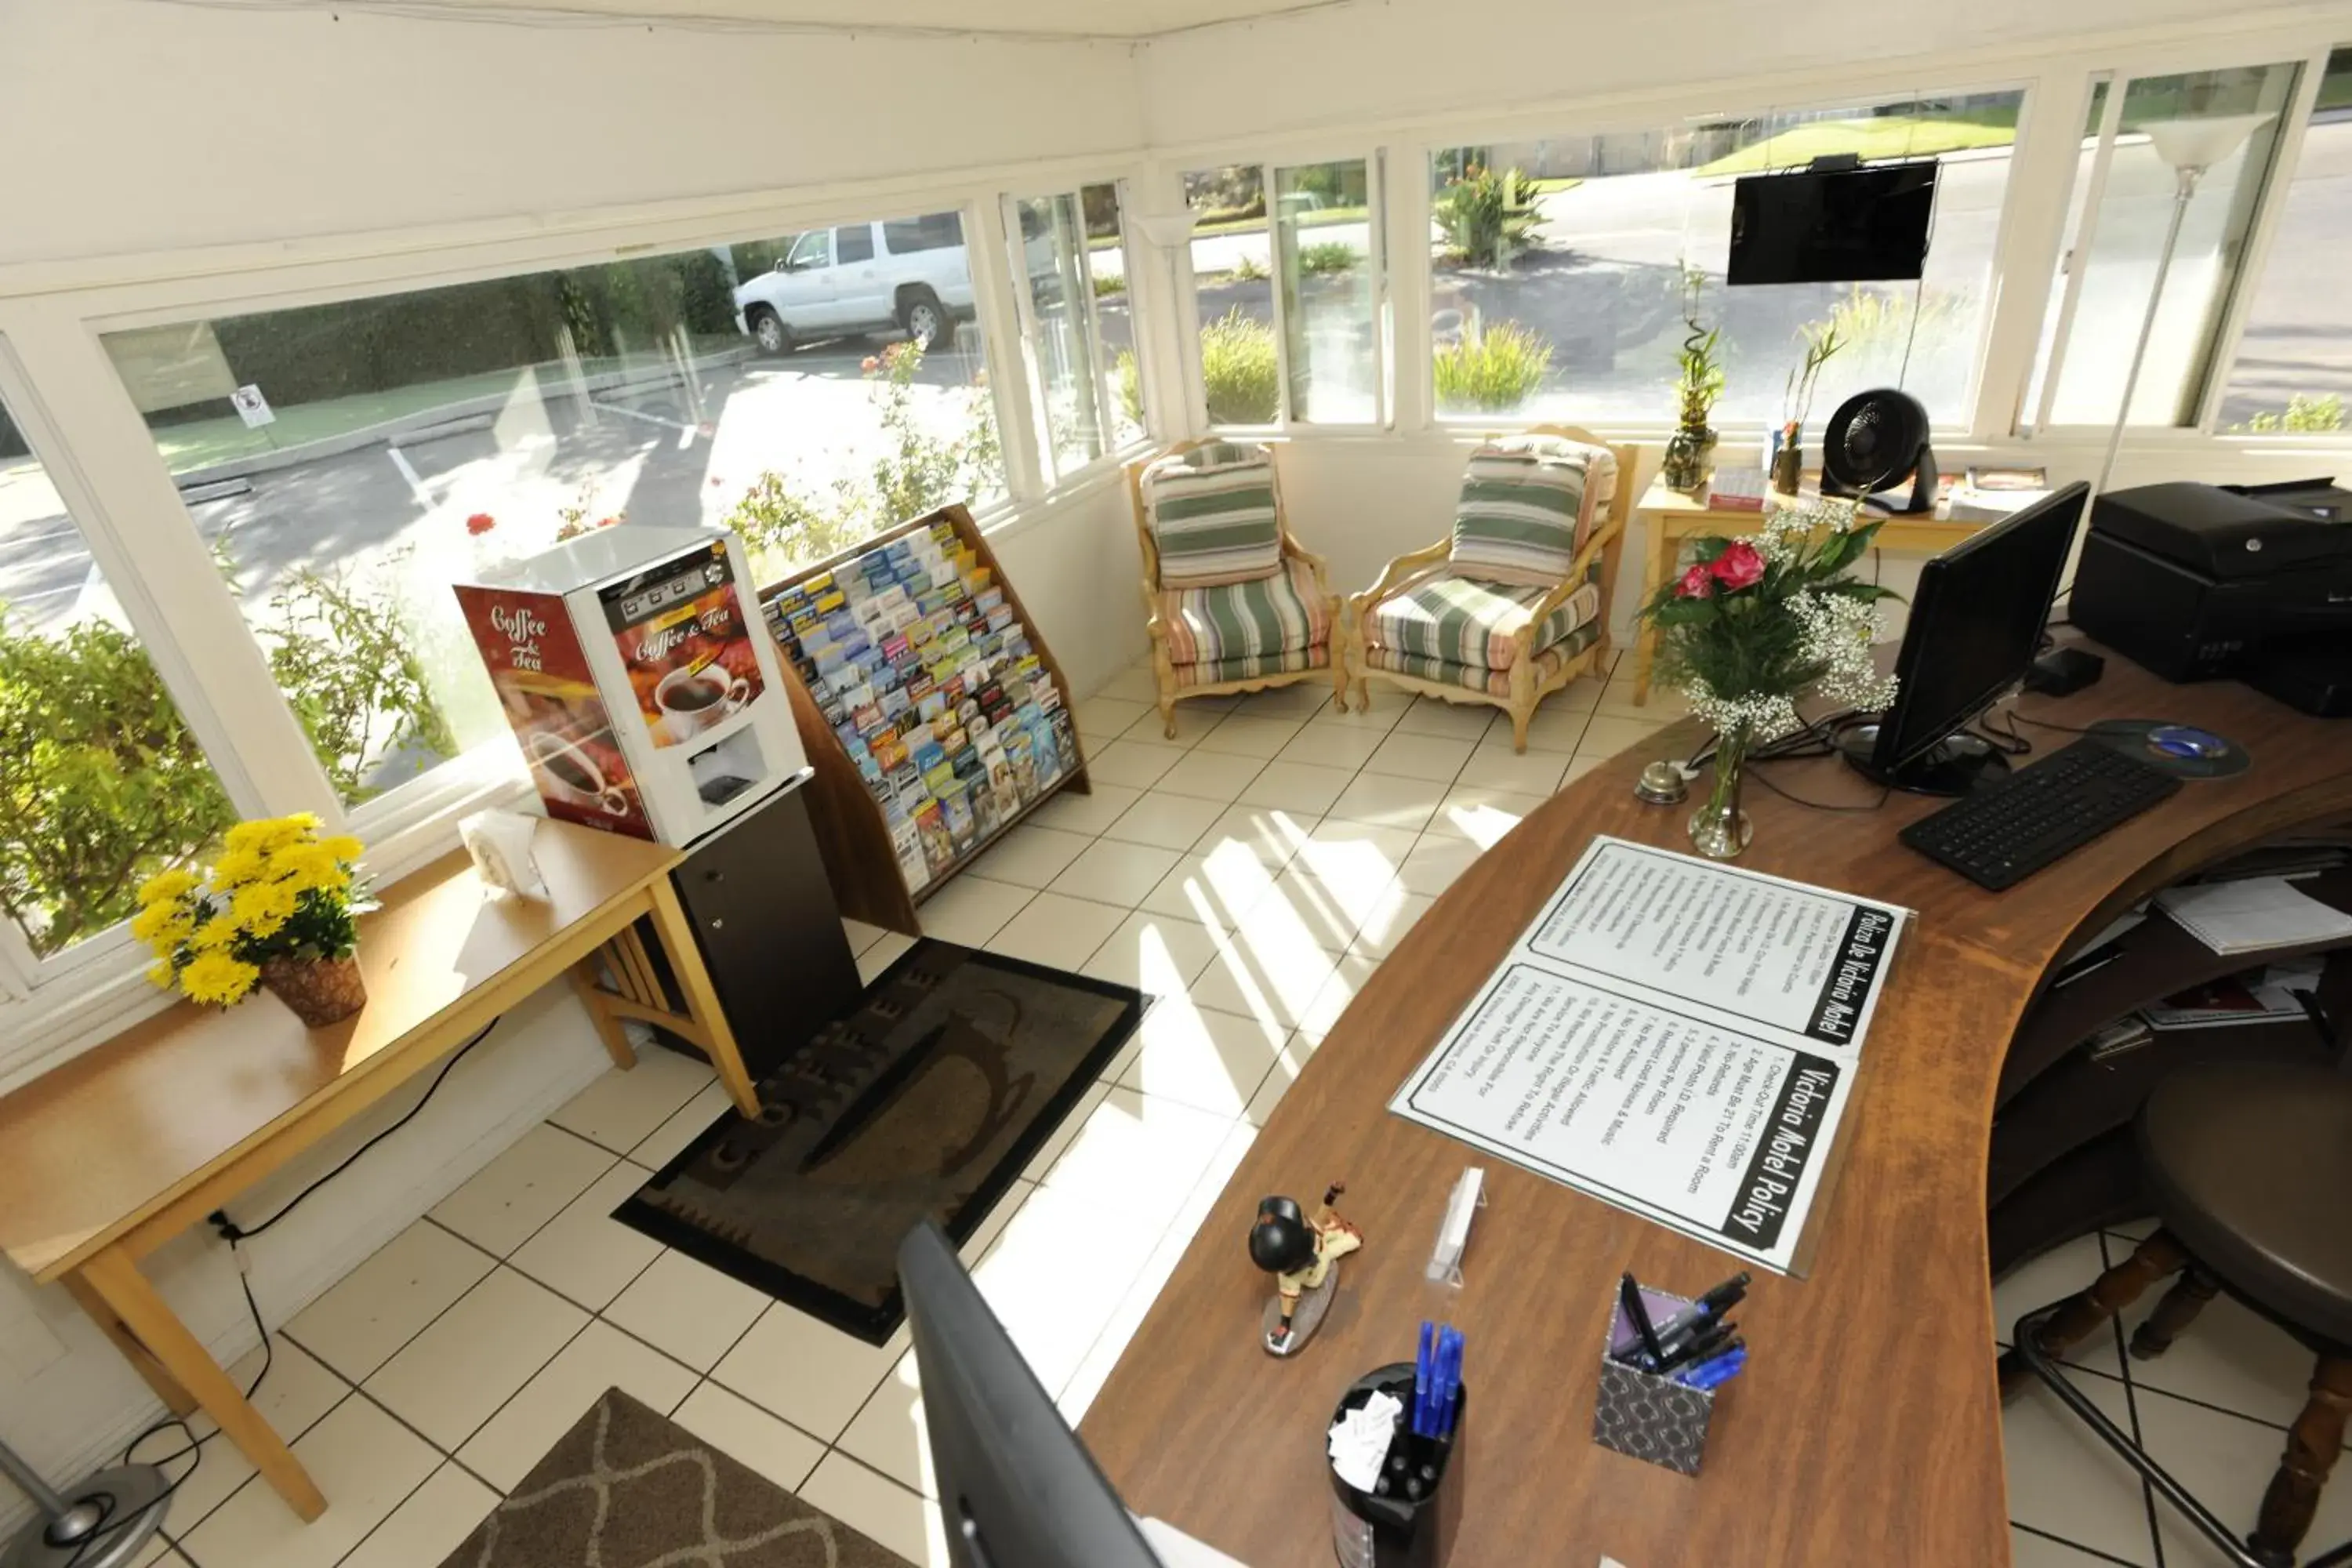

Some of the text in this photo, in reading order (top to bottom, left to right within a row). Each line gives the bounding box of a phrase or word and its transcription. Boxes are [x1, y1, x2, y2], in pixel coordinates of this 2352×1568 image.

[491, 604, 546, 643] Coffee
[635, 629, 686, 662] Coffee
[702, 606, 730, 632] Tea
[510, 645, 542, 671] Tea
[1848, 942, 1876, 957] De
[1831, 960, 1870, 1000] Victoria
[1531, 1007, 1546, 1021] Are
[1599, 1010, 1614, 1022] No
[1620, 1016, 1635, 1028] No
[1818, 1000, 1853, 1037] Motel
[1545, 1022, 1561, 1033] To
[1639, 1022, 1654, 1035] No
[1483, 1044, 1496, 1055] Or
[1526, 1033, 1552, 1062] Anyone
[1573, 1021, 1608, 1064] Prostitution
[1602, 1029, 1627, 1056] Visitors
[1632, 1033, 1648, 1048] Pet
[1650, 1029, 1675, 1059] Restrict
[1548, 1051, 1566, 1065] The
[1613, 1047, 1639, 1080] Allowed
[1697, 1043, 1716, 1065] Valid
[1742, 1056, 1759, 1074] Age
[711, 966, 942, 1172] COFFEE
[1533, 1065, 1555, 1089] Right
[1566, 1064, 1580, 1076] Or
[1581, 1065, 1605, 1091] Traffic
[1638, 1058, 1657, 1081] Loud
[1684, 1063, 1706, 1087] Photo
[1478, 1081, 1494, 1098] For
[1660, 1074, 1675, 1089] Per
[1733, 1073, 1752, 1095] Must
[1754, 1064, 1782, 1108] Check-Out
[1524, 1088, 1541, 1101] To
[1621, 1080, 1646, 1109] Noises
[1645, 1089, 1667, 1115] Room
[1726, 1094, 1742, 1108] Be
[1504, 1101, 1531, 1131] Refuse
[1559, 1091, 1588, 1126] Allowed
[1722, 1107, 1736, 1120] 21
[1744, 1109, 1763, 1130] Time
[1523, 1101, 1555, 1142] Activities
[1600, 1118, 1624, 1145] Music
[1656, 1103, 1686, 1144] Required
[1715, 1121, 1731, 1133] To
[1704, 1133, 1724, 1156] Rent
[1733, 1069, 1830, 1232] Victoria Motel Policy
[1687, 1164, 1710, 1194] Room
